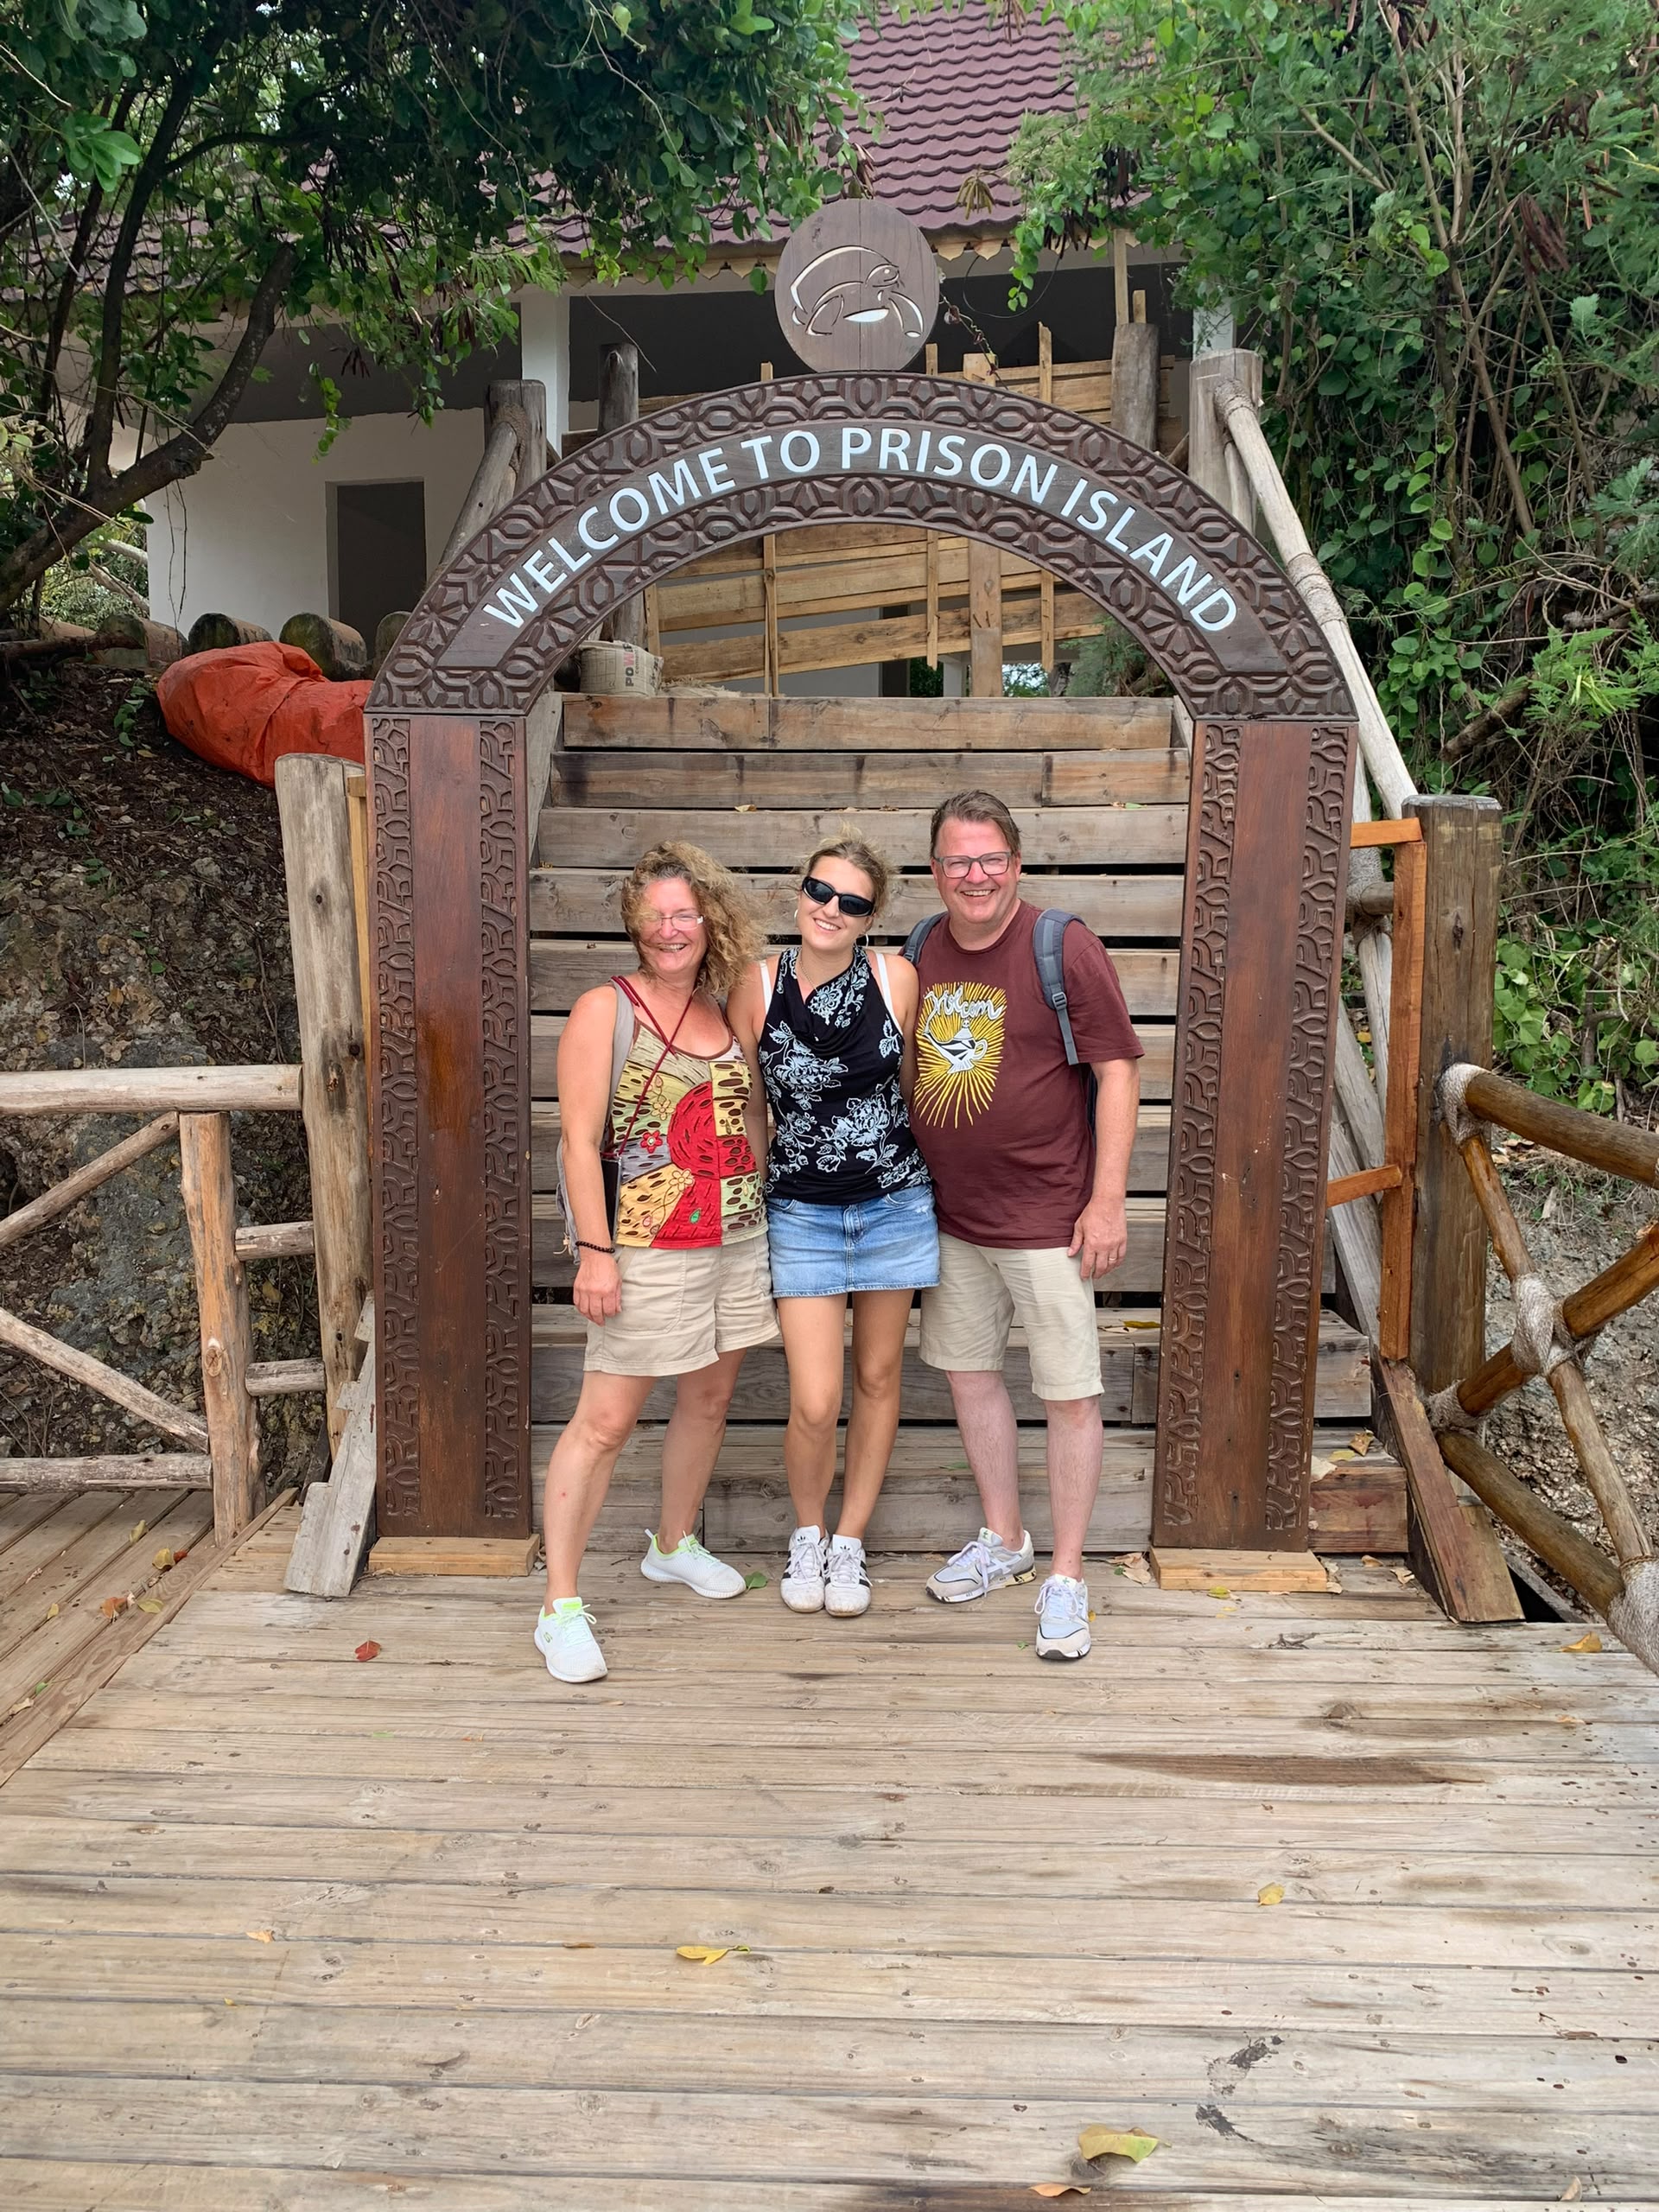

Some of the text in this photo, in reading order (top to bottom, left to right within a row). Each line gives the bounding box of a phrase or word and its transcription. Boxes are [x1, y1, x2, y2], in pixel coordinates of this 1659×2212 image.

[482, 427, 1238, 632] WELCOME TO PRISON ISLAND
